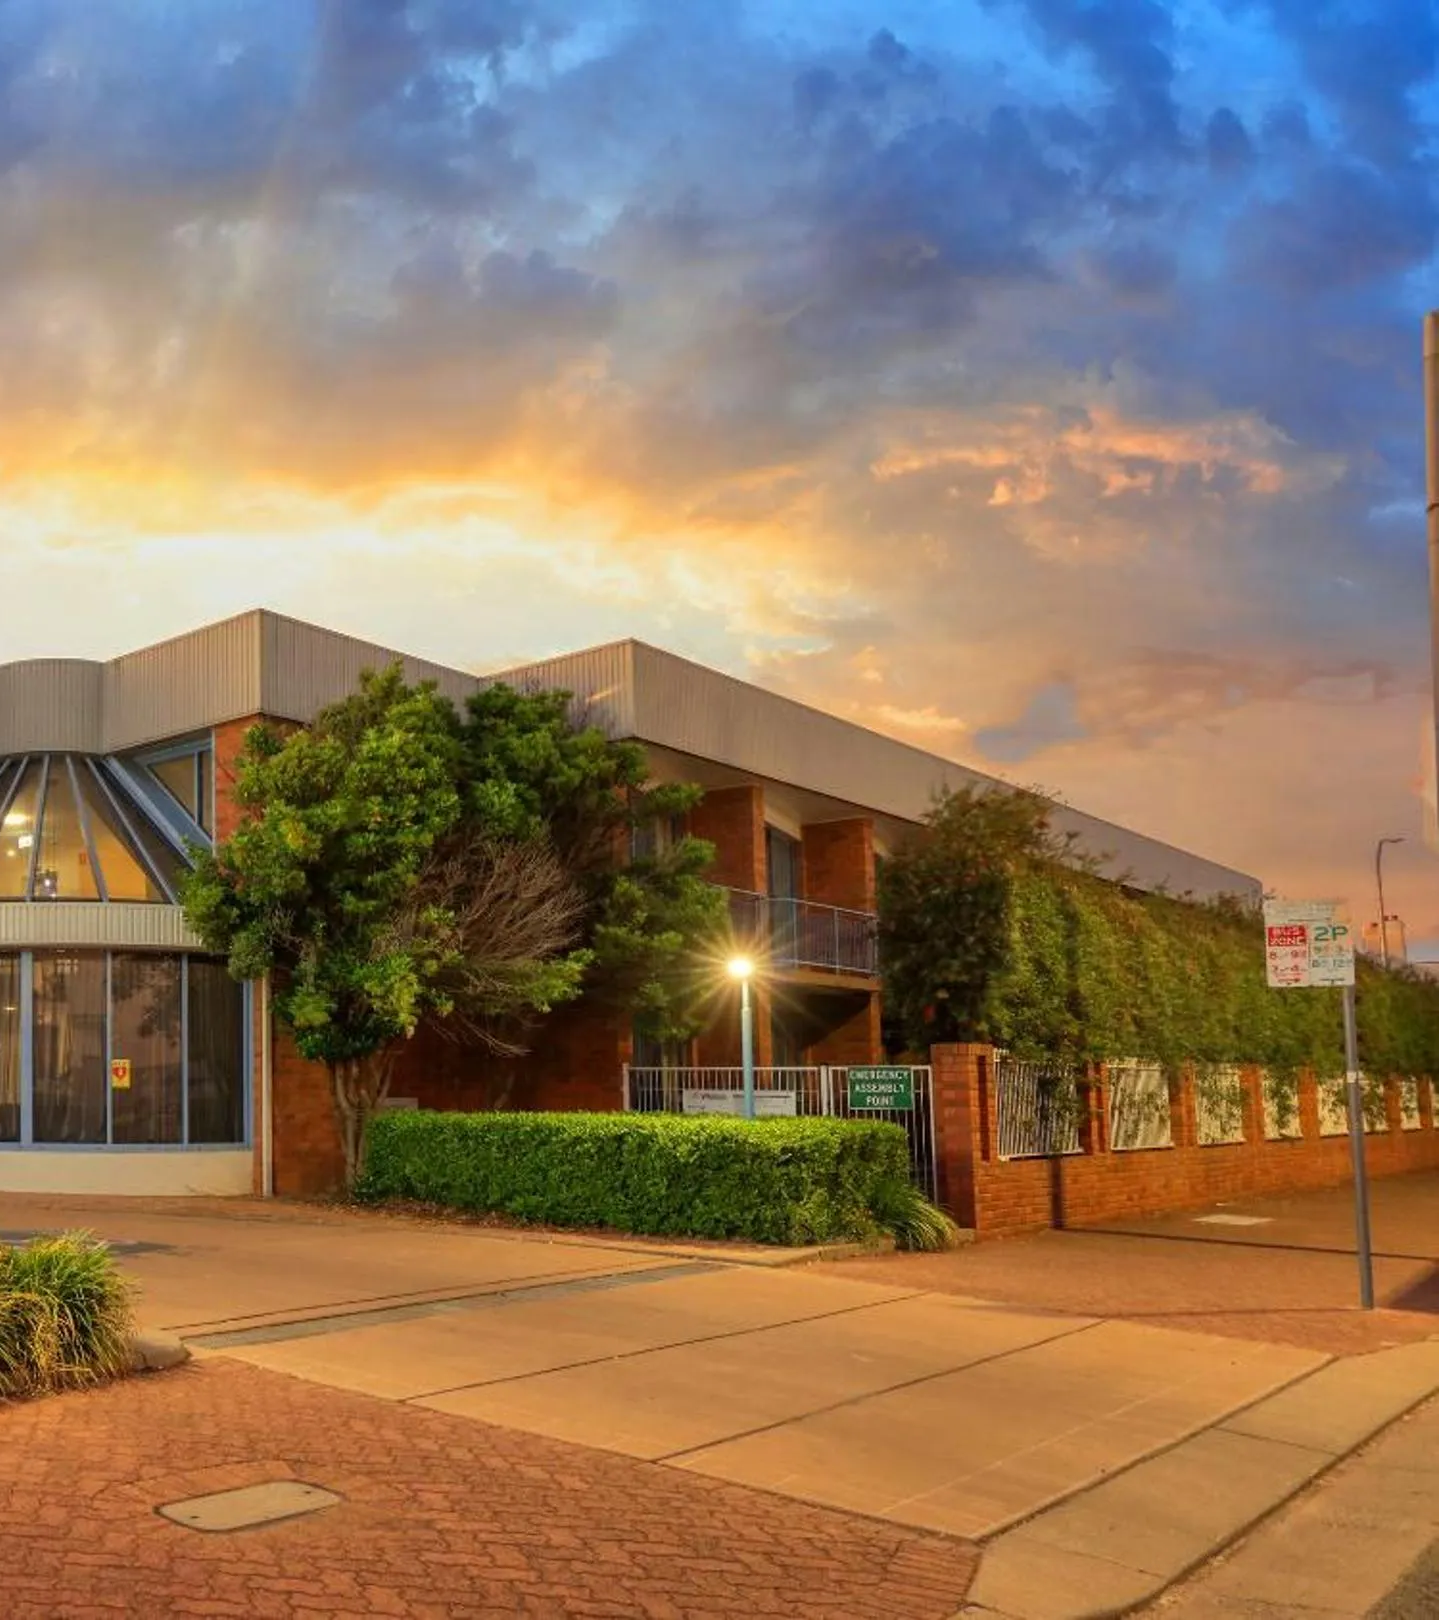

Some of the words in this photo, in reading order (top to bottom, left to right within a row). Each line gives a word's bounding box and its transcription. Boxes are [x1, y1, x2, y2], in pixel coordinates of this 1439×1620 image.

[1314, 926, 1348, 941] 2P
[850, 1070, 908, 1080] EMERGENCY
[855, 1083, 905, 1093] ASSEMBLY
[866, 1095, 894, 1106] POINT
